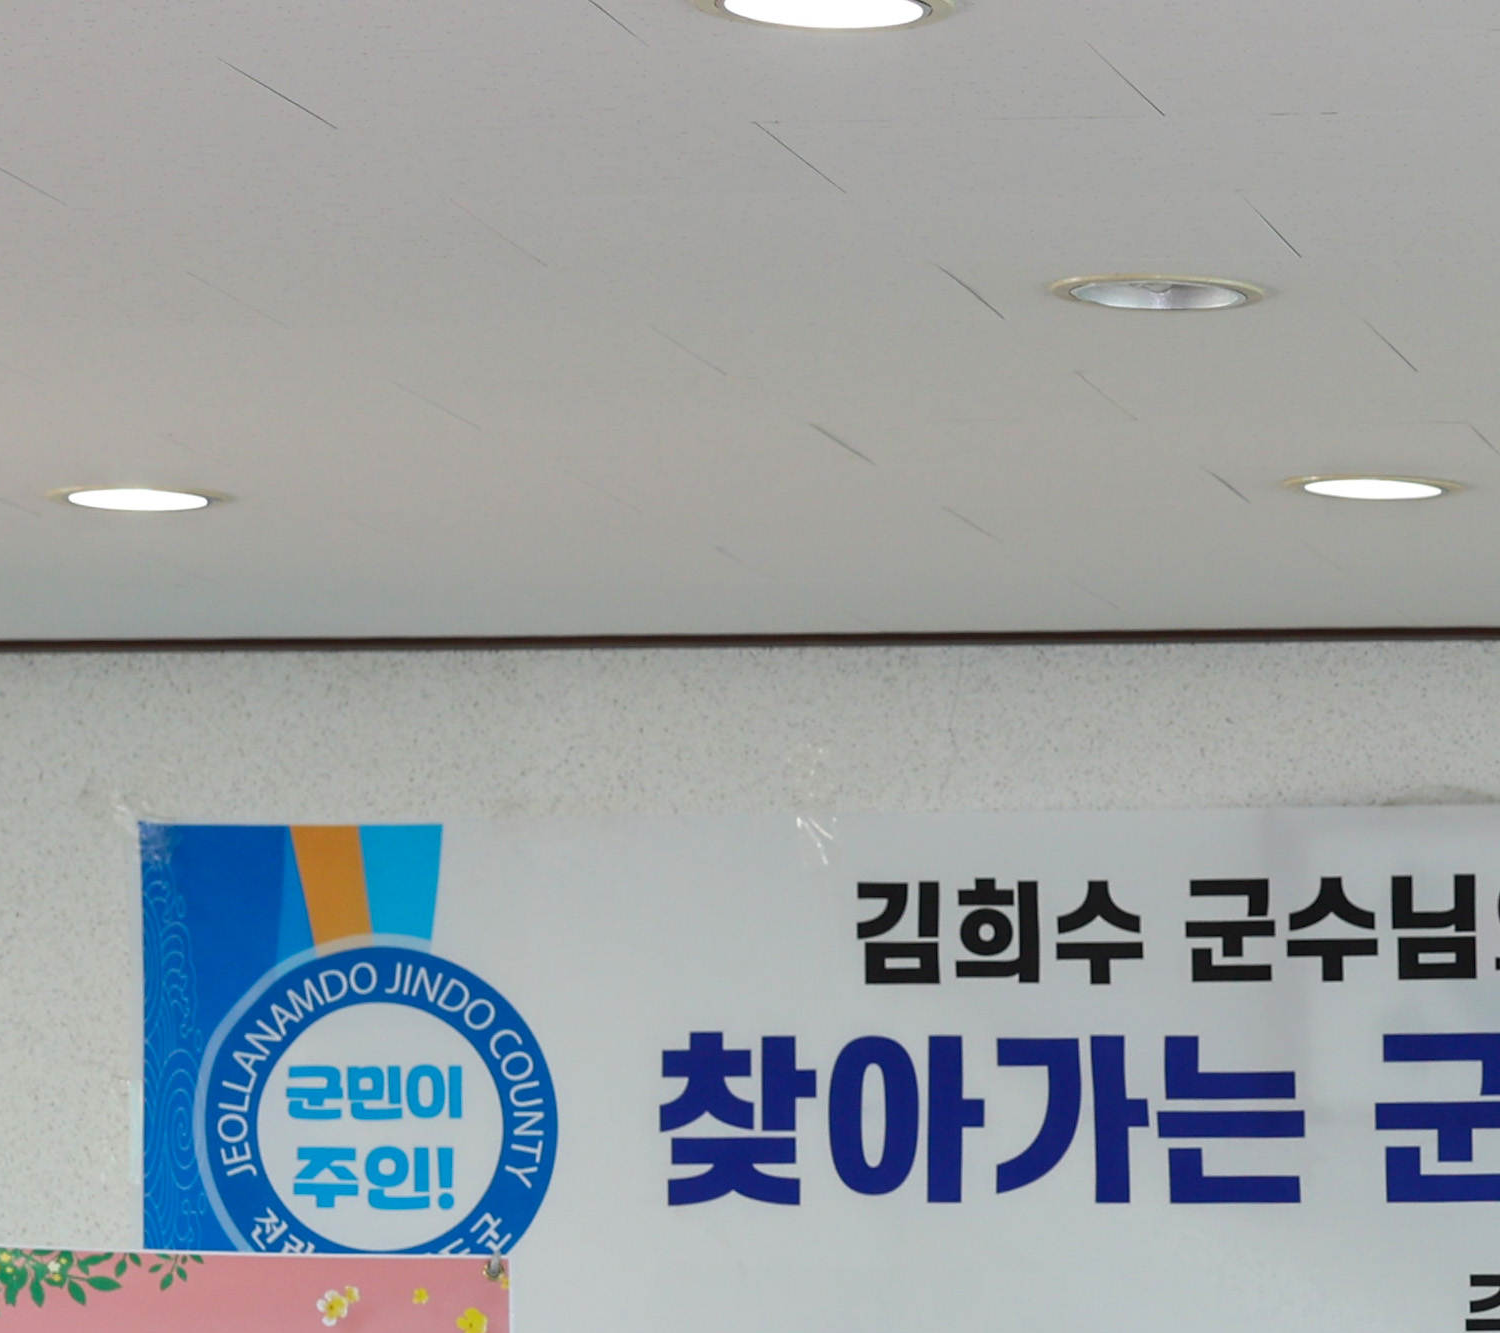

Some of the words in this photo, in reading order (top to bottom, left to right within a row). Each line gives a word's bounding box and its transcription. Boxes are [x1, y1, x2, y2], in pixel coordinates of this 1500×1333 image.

[856, 877, 1144, 985] 김희수
[217, 961, 378, 1178] JEOLLANAMDO
[385, 962, 497, 1031] JINDO
[489, 1028, 546, 1190] COUNTY
[285, 1064, 463, 1121] 군민이
[658, 1031, 1306, 1206] 찾아가는
[292, 1145, 456, 1211] 주인!
